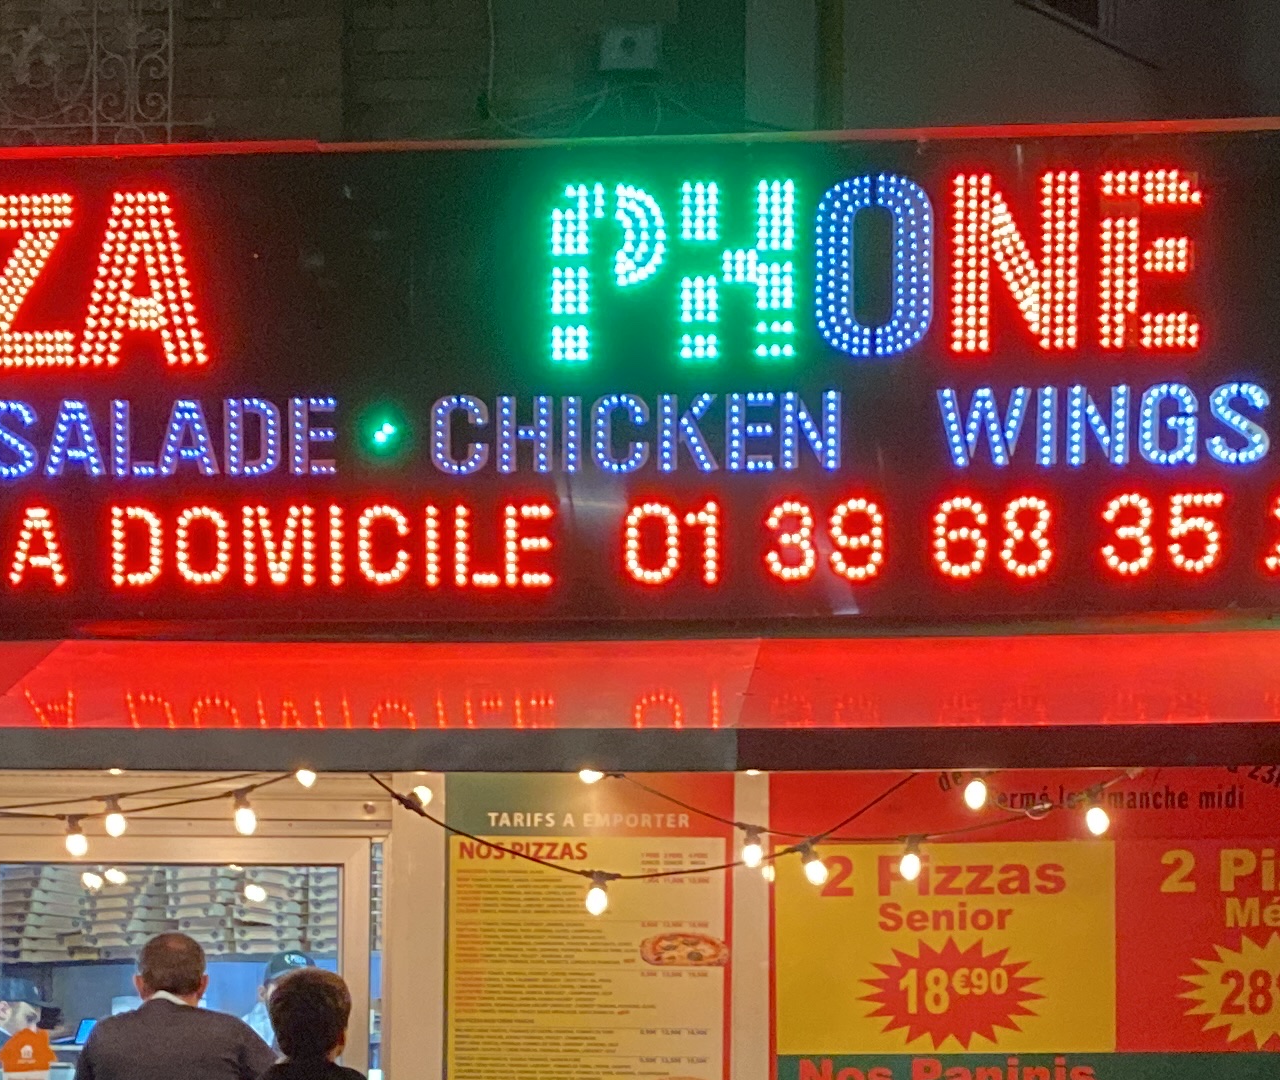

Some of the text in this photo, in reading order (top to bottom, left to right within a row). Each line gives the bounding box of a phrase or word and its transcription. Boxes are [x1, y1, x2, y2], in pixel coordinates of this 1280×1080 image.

[550, 168, 1204, 361] PHONE
[430, 389, 843, 475] CHICKEN
[937, 381, 1271, 466] WINGS
[7, 506, 68, 588] A
[110, 503, 555, 589] DOMICILE
[622, 500, 720, 585] 01
[763, 498, 884, 582] 39
[932, 496, 1052, 579] 68
[1099, 492, 1225, 577] 35
[990, 785, 1050, 809] ermé
[1198, 784, 1245, 810] midi
[487, 812, 690, 829] TARIFS A EMPORTER
[458, 842, 588, 861] NOS PIZZAS
[1160, 850, 1197, 894] 2
[820, 854, 1067, 897] 2 Pizzas
[878, 902, 1013, 932] Senior
